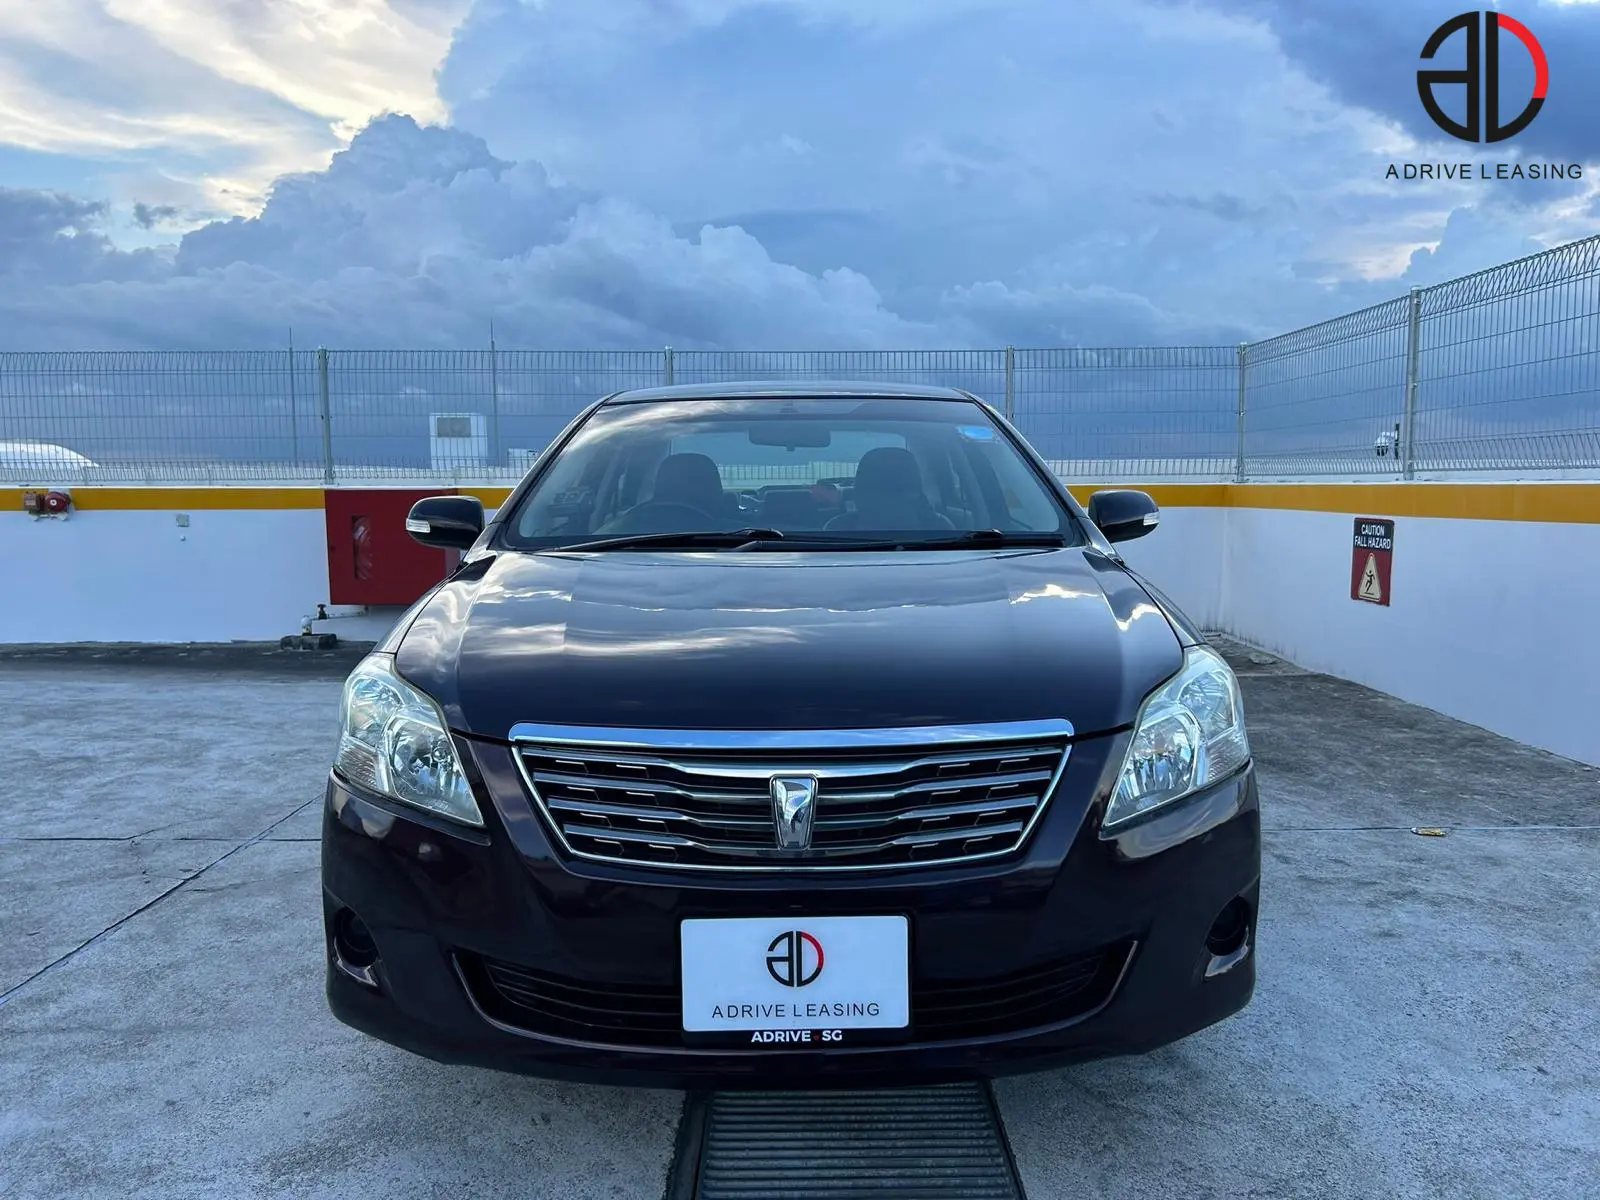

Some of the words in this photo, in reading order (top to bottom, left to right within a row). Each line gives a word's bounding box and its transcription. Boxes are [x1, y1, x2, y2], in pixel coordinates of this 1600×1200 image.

[1361, 524, 1385, 536] CAUTION
[1354, 536, 1367, 547] FALL
[1368, 537, 1391, 549] HAZARD
[712, 1004, 785, 1018] ADRIVE
[793, 1003, 880, 1017] LEASING
